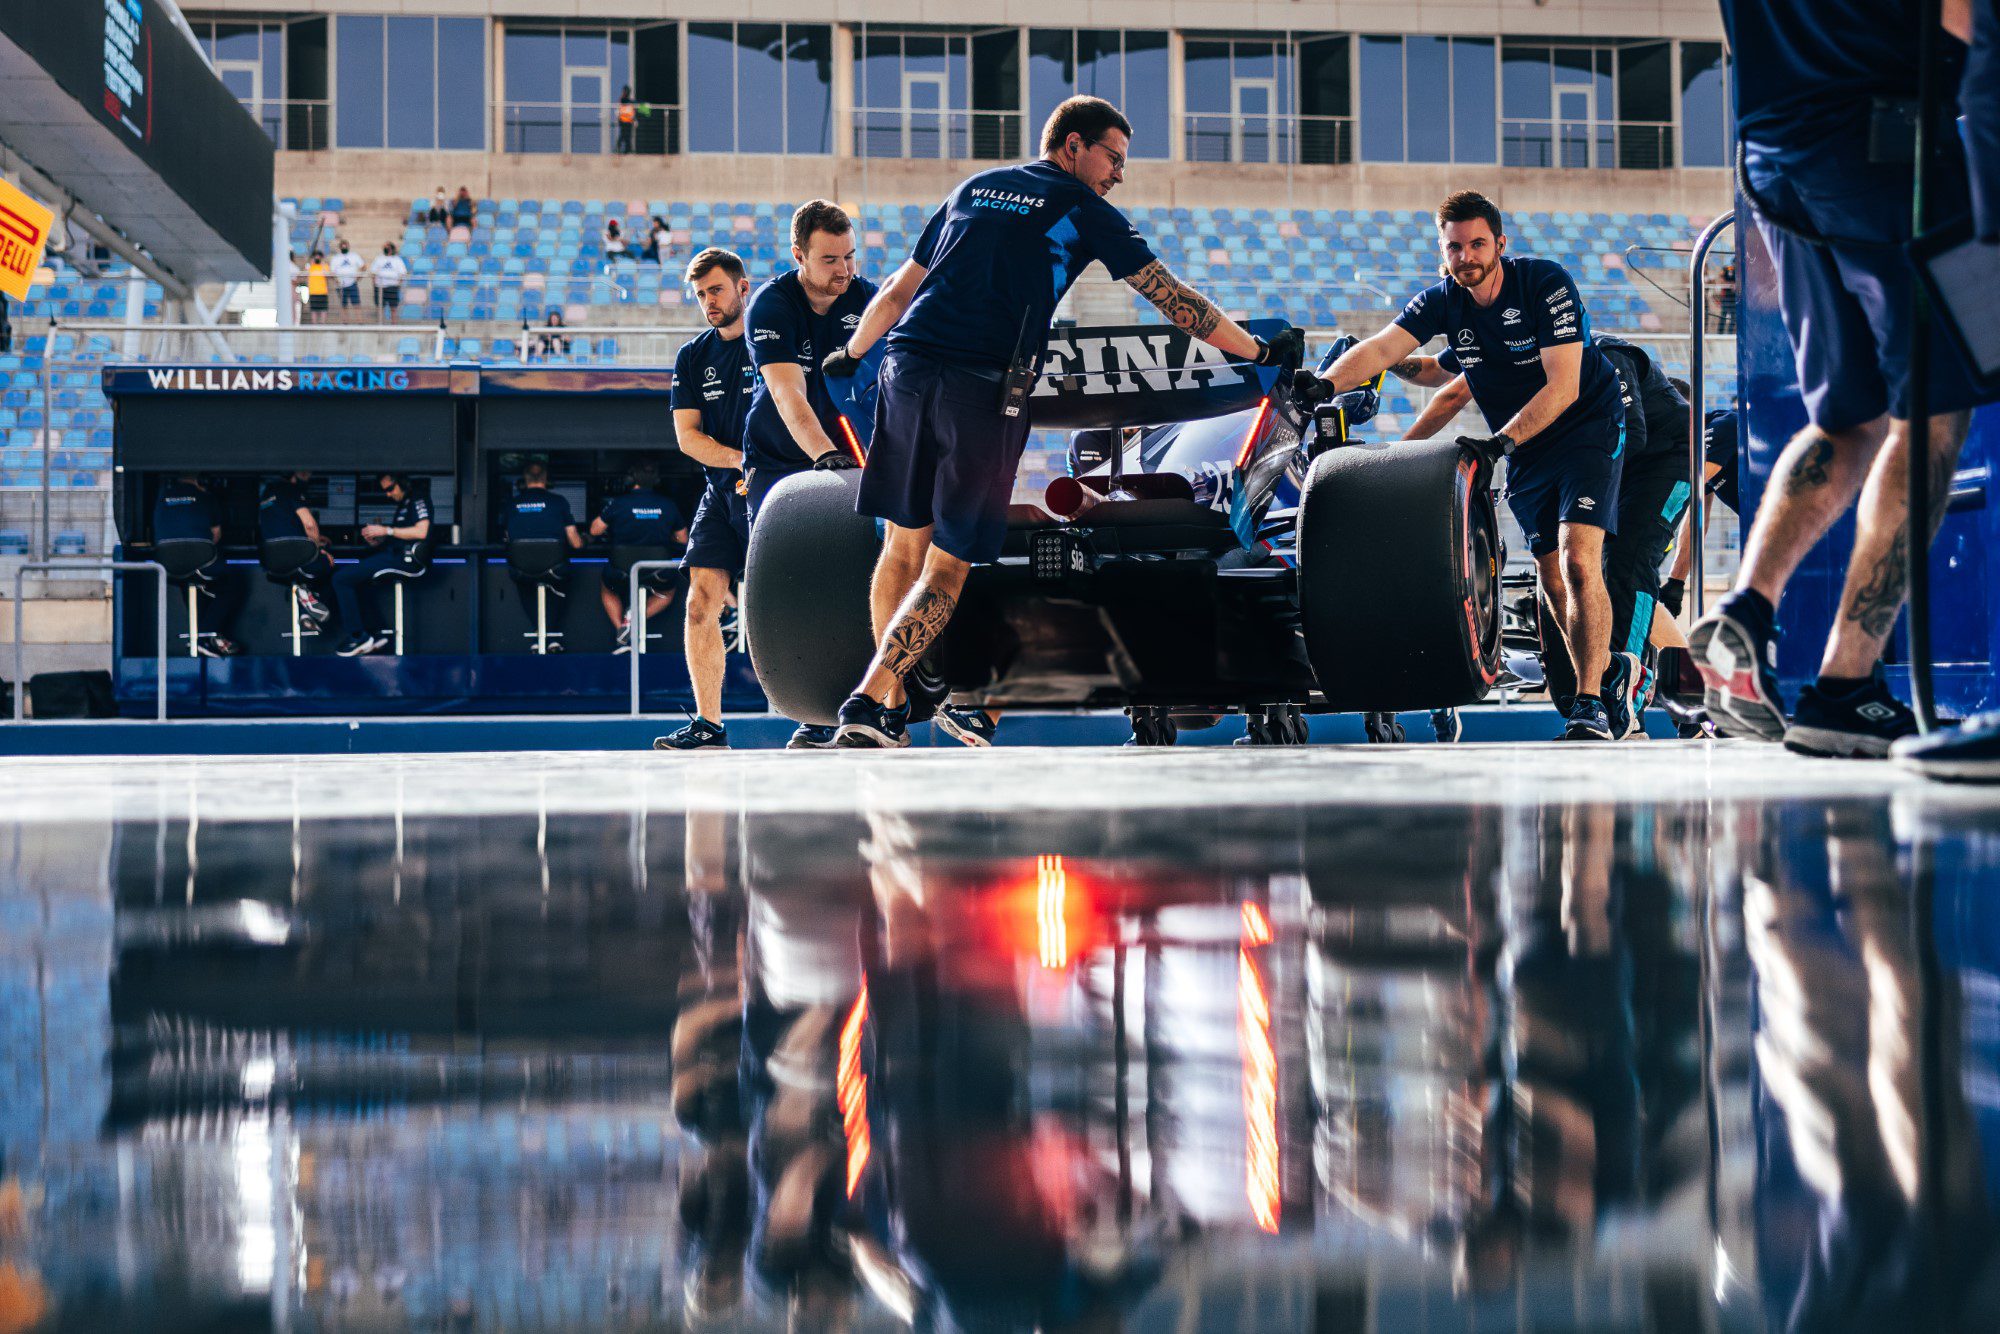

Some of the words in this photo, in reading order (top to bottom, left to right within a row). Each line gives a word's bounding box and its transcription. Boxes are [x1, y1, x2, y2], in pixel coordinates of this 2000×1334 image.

[971, 188, 1045, 208] WILLIAMS
[971, 198, 1030, 215] RACING
[1503, 335, 1537, 347] WILLIAMS
[148, 369, 293, 391] WILLIAMS
[298, 370, 409, 391] RACING
[1071, 543, 1084, 572] sia
